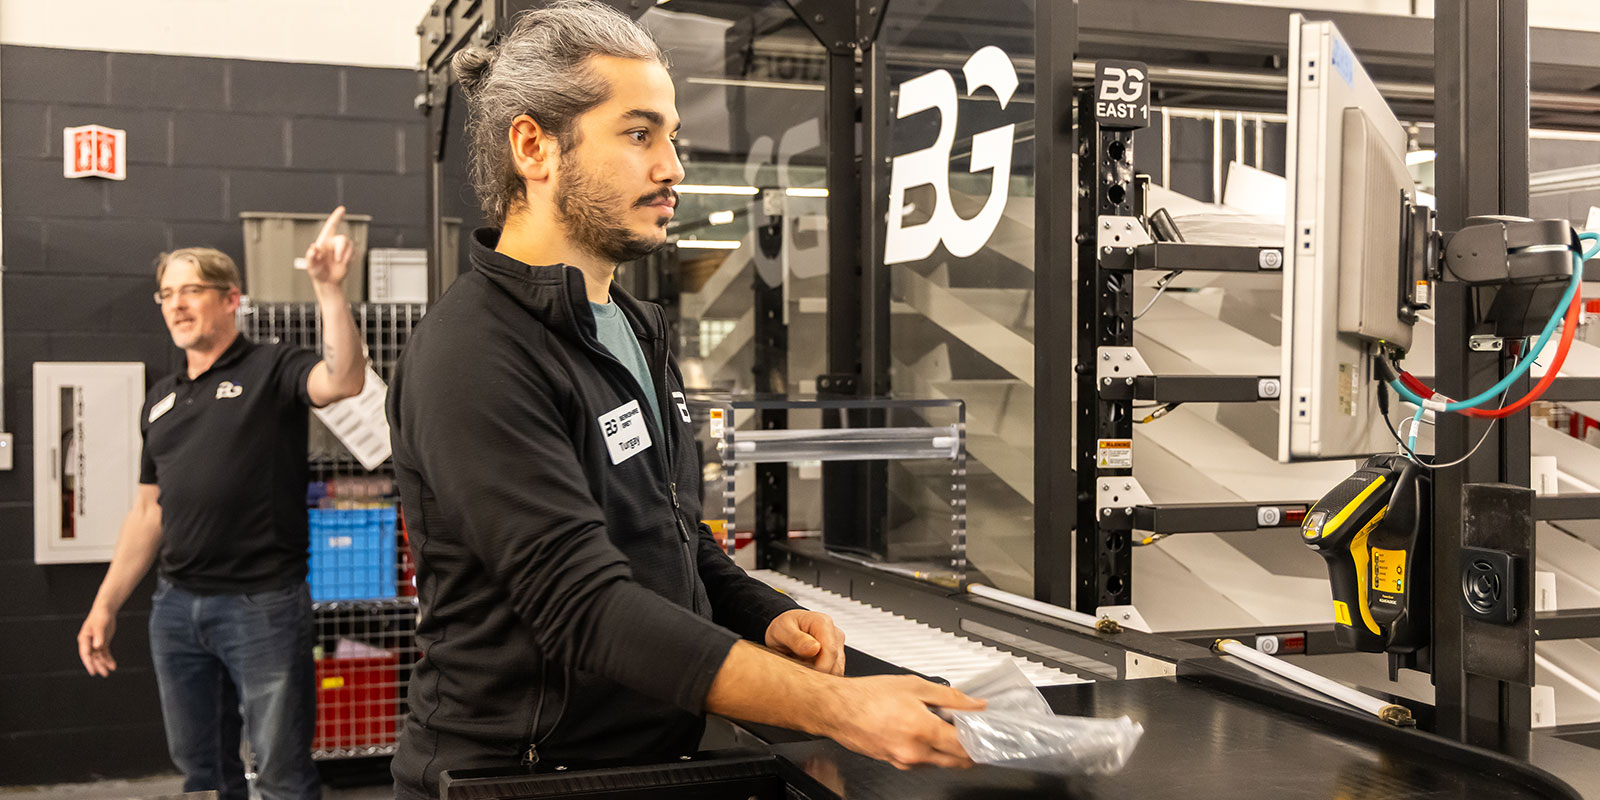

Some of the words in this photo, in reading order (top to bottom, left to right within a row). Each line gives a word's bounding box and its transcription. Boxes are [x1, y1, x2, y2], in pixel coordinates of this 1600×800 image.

[1099, 67, 1145, 102] BG
[1096, 102, 1137, 119] EAST
[1140, 104, 1148, 119] 1
[884, 46, 1020, 265] BG
[604, 419, 618, 437] BG
[618, 436, 640, 451] Turgay
